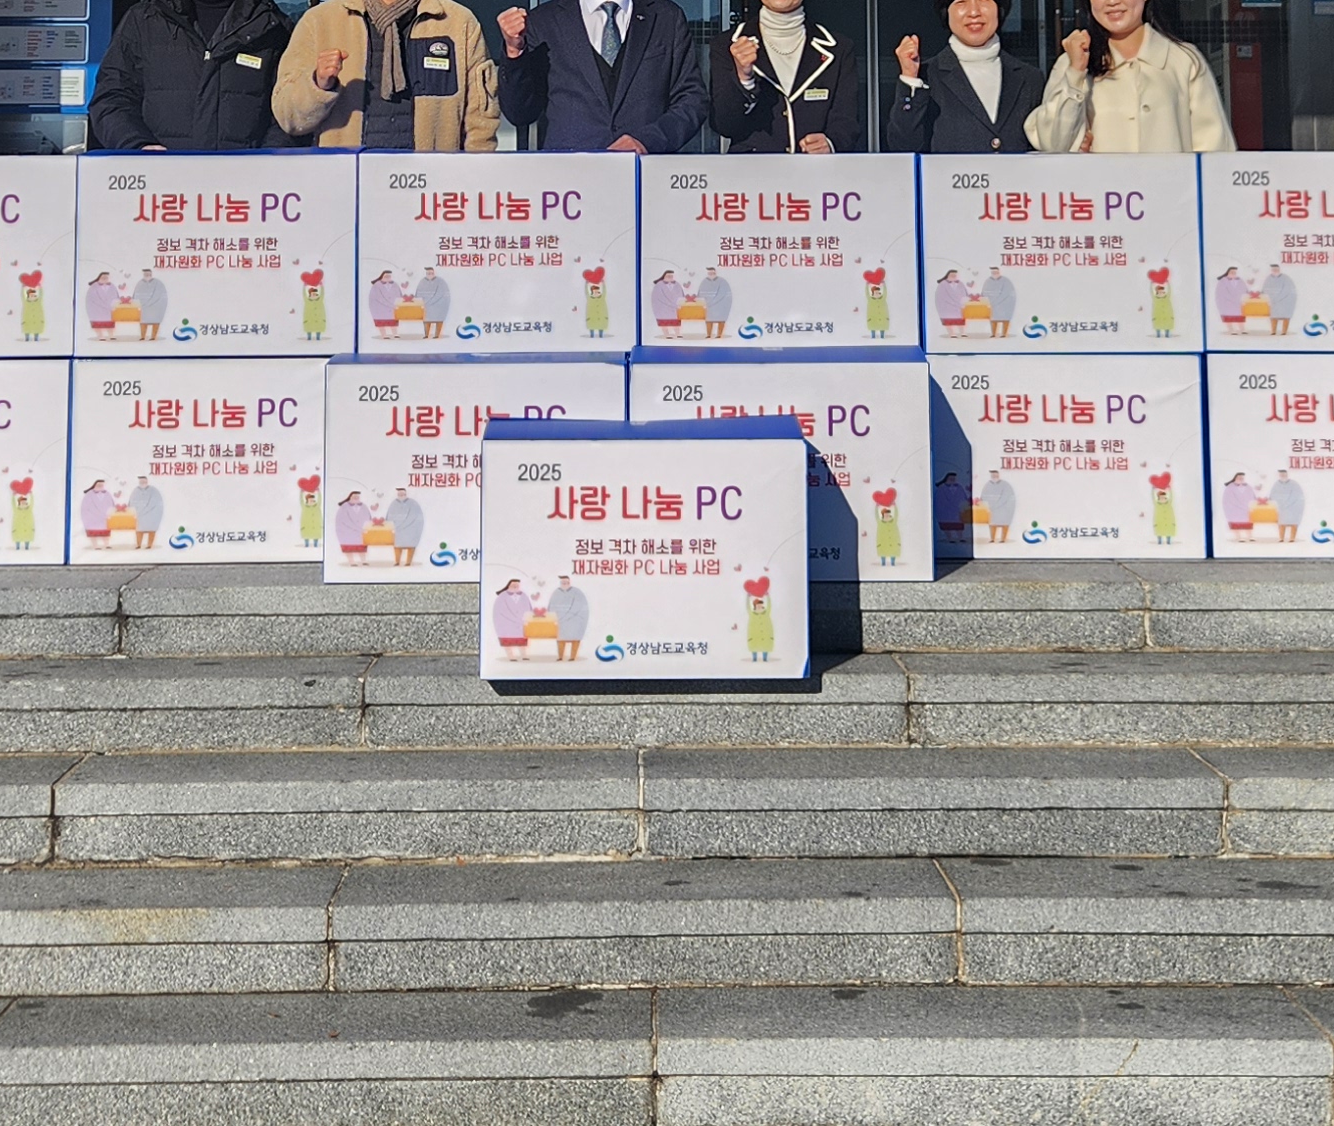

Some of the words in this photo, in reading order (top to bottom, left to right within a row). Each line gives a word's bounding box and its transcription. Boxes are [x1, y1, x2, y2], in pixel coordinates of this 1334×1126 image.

[109, 175, 146, 190] 2025
[389, 174, 426, 189] 2025
[670, 174, 708, 189] 2025
[952, 174, 989, 189] 2025
[1232, 171, 1270, 186] 2025
[133, 194, 188, 223] 사랑
[197, 193, 250, 222] 나눔
[261, 193, 301, 222] PC
[415, 192, 468, 221] 사랑
[478, 192, 531, 220] 나눔
[542, 191, 581, 220] PC
[696, 193, 749, 222] 사랑
[759, 193, 811, 221] 나눔
[823, 192, 861, 221] PC
[979, 192, 1032, 221] 사랑
[1041, 192, 1094, 221] 나눔
[1105, 191, 1144, 220] PC
[1259, 190, 1312, 219] 사랑
[157, 238, 181, 252] 정보
[186, 238, 209, 251] 격차
[213, 238, 250, 251] 해소를
[254, 237, 278, 251] 위한
[439, 237, 462, 250] 정보
[467, 236, 491, 250] 격차
[495, 236, 530, 249] 해소를
[535, 235, 559, 249] 위한
[720, 237, 744, 250] 정보
[748, 237, 772, 250] 격차
[776, 237, 811, 250] 해소를
[816, 236, 840, 250] 위한
[154, 255, 202, 269] 재자원화
[206, 255, 224, 269] PC
[229, 255, 253, 268] 나눔
[257, 255, 281, 268] 사업
[436, 253, 484, 267] 재자원화
[489, 253, 506, 267] PC
[511, 253, 534, 266] 나눔
[539, 253, 562, 266] 사업
[718, 254, 765, 267] 재자원화
[769, 254, 787, 267] PC
[792, 254, 815, 267] 나눔
[820, 253, 843, 267] 사업
[200, 324, 269, 335] 경상남도교육청
[483, 321, 552, 333] 경상남도교육청
[765, 322, 833, 333] 경상남도교육청
[1049, 321, 1118, 332] 경상남도교육청
[103, 381, 141, 396] 2025
[952, 375, 989, 390] 2025
[1239, 374, 1277, 389] 2025
[359, 385, 399, 401] 2025
[663, 385, 703, 401] 2025
[129, 399, 183, 429] 사랑
[193, 399, 246, 428] 나눔
[258, 398, 297, 427] PC
[978, 394, 1032, 424] 사랑
[1042, 394, 1095, 424] 나눔
[1107, 395, 1146, 424] PC
[1266, 394, 1319, 423] 사랑
[386, 406, 444, 437] 사랑
[828, 405, 870, 437] PC
[153, 445, 177, 458] 정보
[182, 444, 205, 458] 격차
[209, 444, 246, 457] 해소를
[250, 443, 275, 457] 위한
[1003, 439, 1027, 453] 정보
[1032, 439, 1056, 452] 격차
[1060, 440, 1096, 453] 해소를
[1101, 440, 1125, 453] 위한
[412, 455, 437, 469] 정보
[443, 454, 468, 469] 격차
[821, 453, 847, 468] 위한
[1001, 457, 1049, 470] 재자원화
[1054, 457, 1072, 470] PC
[1076, 457, 1100, 470] 나눔
[1105, 457, 1128, 470] 사업
[149, 462, 198, 476] 재자원화
[203, 461, 220, 475] PC
[225, 461, 249, 475] 나눔
[253, 461, 277, 474] 사업
[518, 464, 561, 481] 2025
[408, 473, 461, 488] 재자원화
[825, 472, 851, 487] 사업
[547, 486, 610, 521] 사랑
[622, 486, 683, 520] 나눔
[697, 486, 742, 520] PC
[196, 531, 266, 543] 경상남도교육청
[1049, 527, 1119, 538] 경상남도교육청
[576, 539, 603, 555] 정보
[609, 539, 637, 554] 격차
[642, 539, 683, 555] 해소를
[689, 539, 717, 555] 위한
[572, 559, 628, 575] 재자원화
[634, 559, 654, 575] PC
[660, 559, 687, 575] 나눔
[693, 559, 720, 575] 사업
[627, 642, 708, 655] 경상남도교육청
